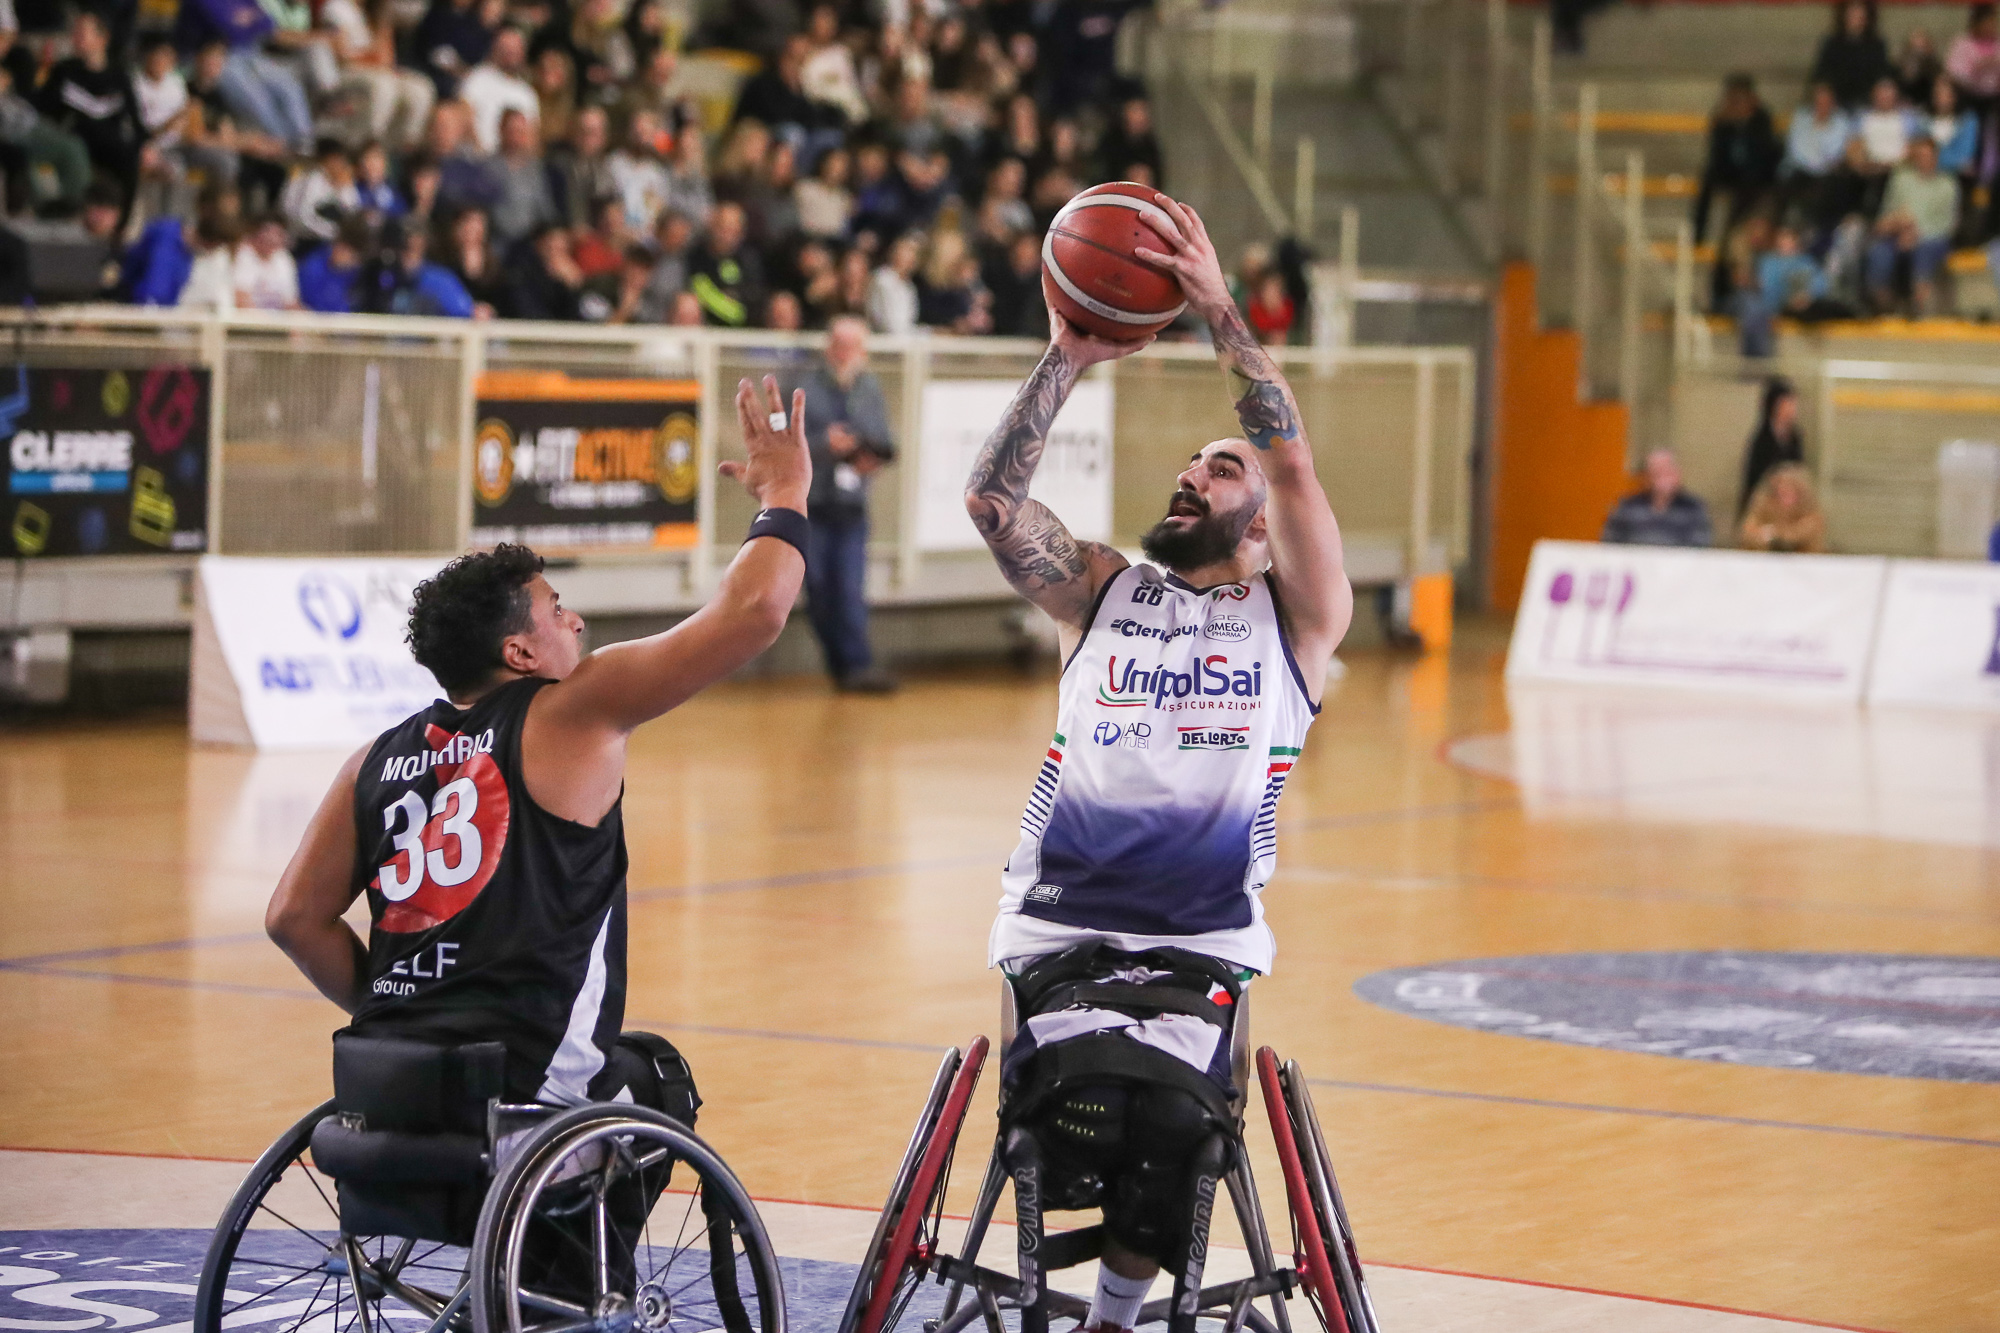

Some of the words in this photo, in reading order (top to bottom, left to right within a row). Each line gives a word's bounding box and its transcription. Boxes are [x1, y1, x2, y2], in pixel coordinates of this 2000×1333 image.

[1207, 622, 1247, 633] OMEGA
[1108, 655, 1262, 709] UnipolSai
[1162, 700, 1262, 712] ASSICURAZIONI
[1125, 722, 1152, 737] AD
[1123, 736, 1150, 750] TUBI
[379, 776, 483, 901] 33
[1066, 1101, 1105, 1112] KIPSTA
[1057, 1119, 1095, 1137] KIPSTA
